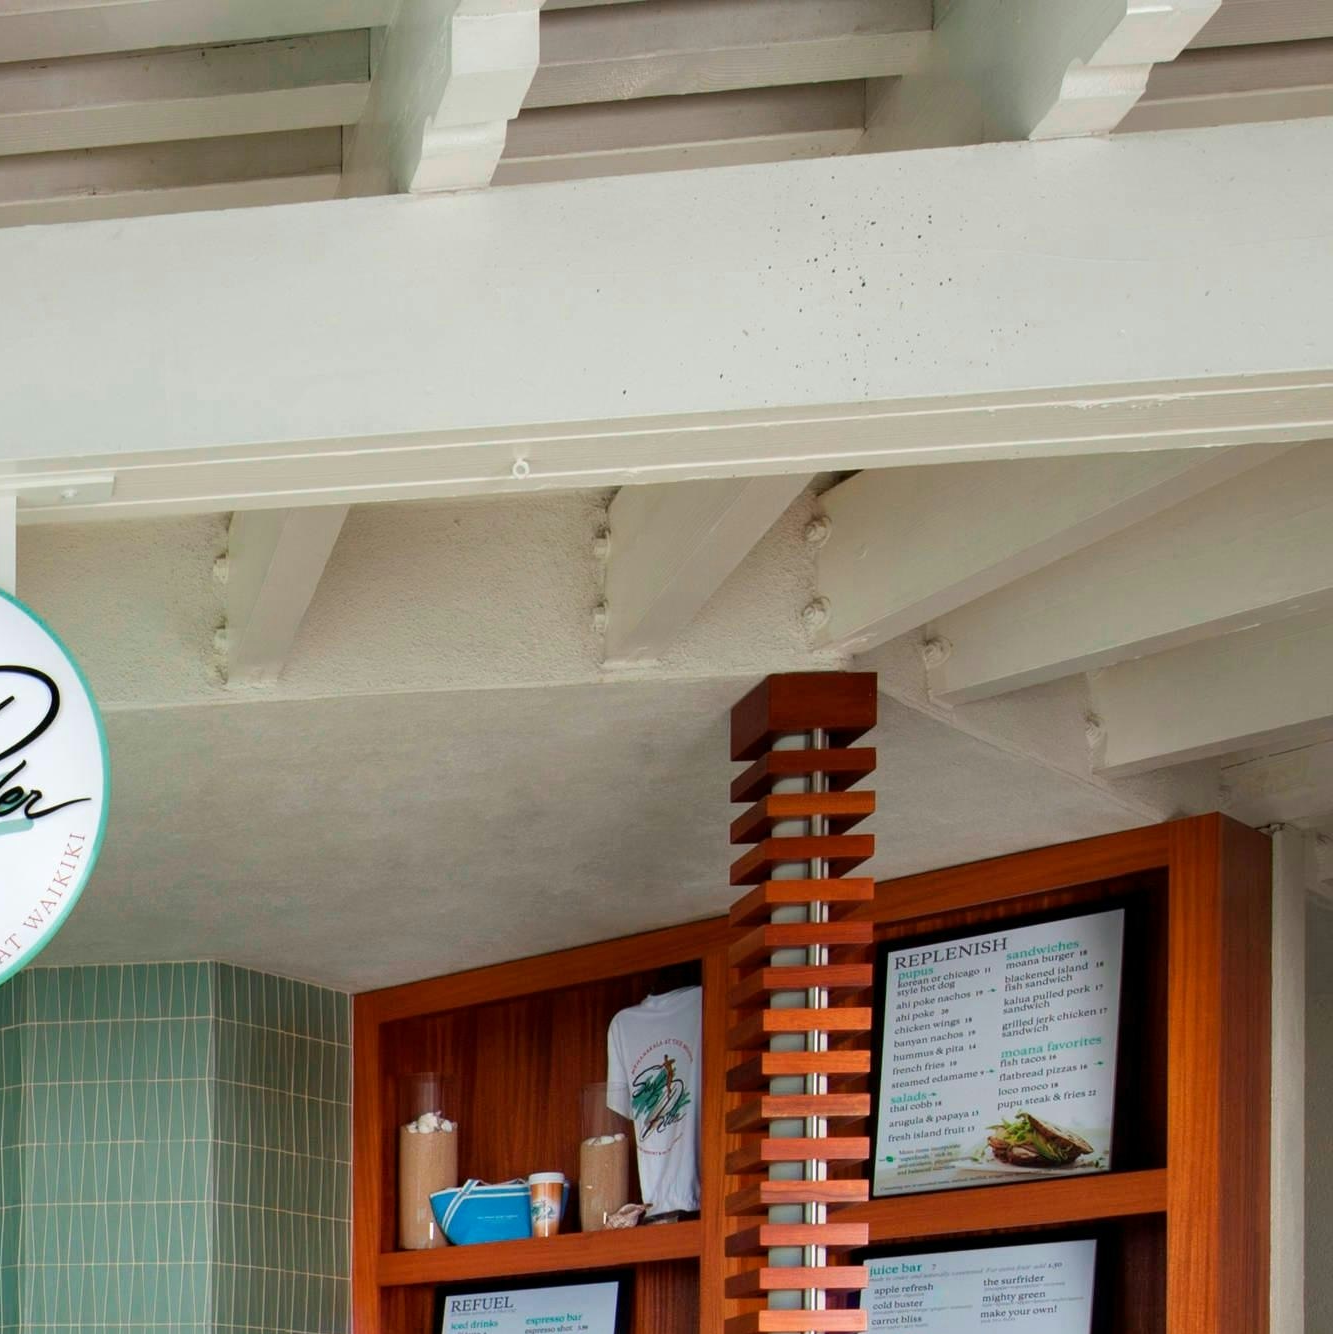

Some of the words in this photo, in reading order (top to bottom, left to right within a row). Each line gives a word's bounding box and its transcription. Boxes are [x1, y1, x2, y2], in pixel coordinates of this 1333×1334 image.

[24, 832, 87, 929] WAIKIKI
[894, 937, 1008, 970] REPLENISH
[1006, 940, 1080, 961] sandwiches
[1006, 959, 1039, 969] moana
[1042, 951, 1075, 966] burger
[897, 977, 929, 988] korean
[943, 968, 980, 982] chicago
[898, 967, 934, 981] pupus
[1005, 970, 1055, 983] blackened
[1058, 963, 1089, 974] island
[897, 987, 918, 997] style
[920, 983, 936, 992] hot
[939, 980, 955, 990] dog
[1004, 982, 1023, 992] fish
[1025, 974, 1073, 989] sandwich
[896, 1001, 911, 1010] ahi
[913, 997, 935, 1008] poke
[937, 992, 971, 1003] nachos
[1004, 996, 1030, 1006] kalua
[1033, 989, 1064, 1003] pulled
[1066, 986, 1091, 998] pork
[895, 1014, 910, 1022] ahi
[912, 1010, 935, 1021] poke
[1002, 1001, 1050, 1015] sandwich
[894, 1023, 931, 1035] chicken
[933, 1018, 960, 1031] wings
[1002, 1018, 1034, 1031] grilled
[1036, 1015, 1055, 1025] jerk
[1057, 1008, 1096, 1021] chicken
[894, 1036, 928, 1048] banyan
[931, 1030, 963, 1041] nachos
[1001, 1025, 1049, 1038] sandwich
[893, 1051, 933, 1062] hummus
[946, 1045, 964, 1056] pita
[1001, 1044, 1044, 1059] moana
[1047, 1036, 1103, 1052] favorites
[892, 1065, 923, 1076] french
[925, 1061, 945, 1069] fries
[1000, 1058, 1019, 1068] fish
[1021, 1055, 1046, 1064] tacos
[891, 1077, 930, 1089] steamed
[932, 1070, 978, 1082] edamame
[999, 1068, 1044, 1082] flatbread
[1046, 1065, 1077, 1078] pizzas
[890, 1092, 927, 1103] salads
[998, 1087, 1019, 1096] loco
[1021, 1084, 1049, 1093] moco
[890, 1104, 908, 1113] thai
[910, 1100, 933, 1110] cobb
[997, 1099, 1023, 1110] pupu
[1025, 1095, 1051, 1105] steak
[1053, 1093, 1061, 1101] &
[1063, 1091, 1086, 1099] fries
[889, 1117, 924, 1129] arugula
[926, 1114, 933, 1122] &
[936, 1112, 969, 1124] papaya
[888, 1133, 912, 1143] fresh
[914, 1129, 942, 1138] island
[944, 1126, 965, 1135] fruit
[869, 1266, 899, 1277] juice
[901, 1263, 922, 1274] bar
[983, 1278, 999, 1286] the
[1001, 1274, 1045, 1285] surfrider
[874, 1285, 899, 1295] apple
[901, 1283, 934, 1293] refresh
[982, 1292, 1016, 1303] mighty
[1018, 1290, 1046, 1299] green
[451, 1296, 514, 1312] REFUEL
[873, 1302, 892, 1310] cold
[894, 1300, 923, 1309] buster
[980, 1309, 1006, 1318] make
[1008, 1307, 1031, 1318] your
[1033, 1305, 1058, 1314] own!
[471, 1320, 498, 1328] drinks
[525, 1315, 564, 1325] espresso
[567, 1313, 582, 1321] bar
[871, 1317, 899, 1326] carrot
[901, 1315, 922, 1324] bliss
[525, 1326, 555, 1334] espresso
[557, 1325, 572, 1333] shot
